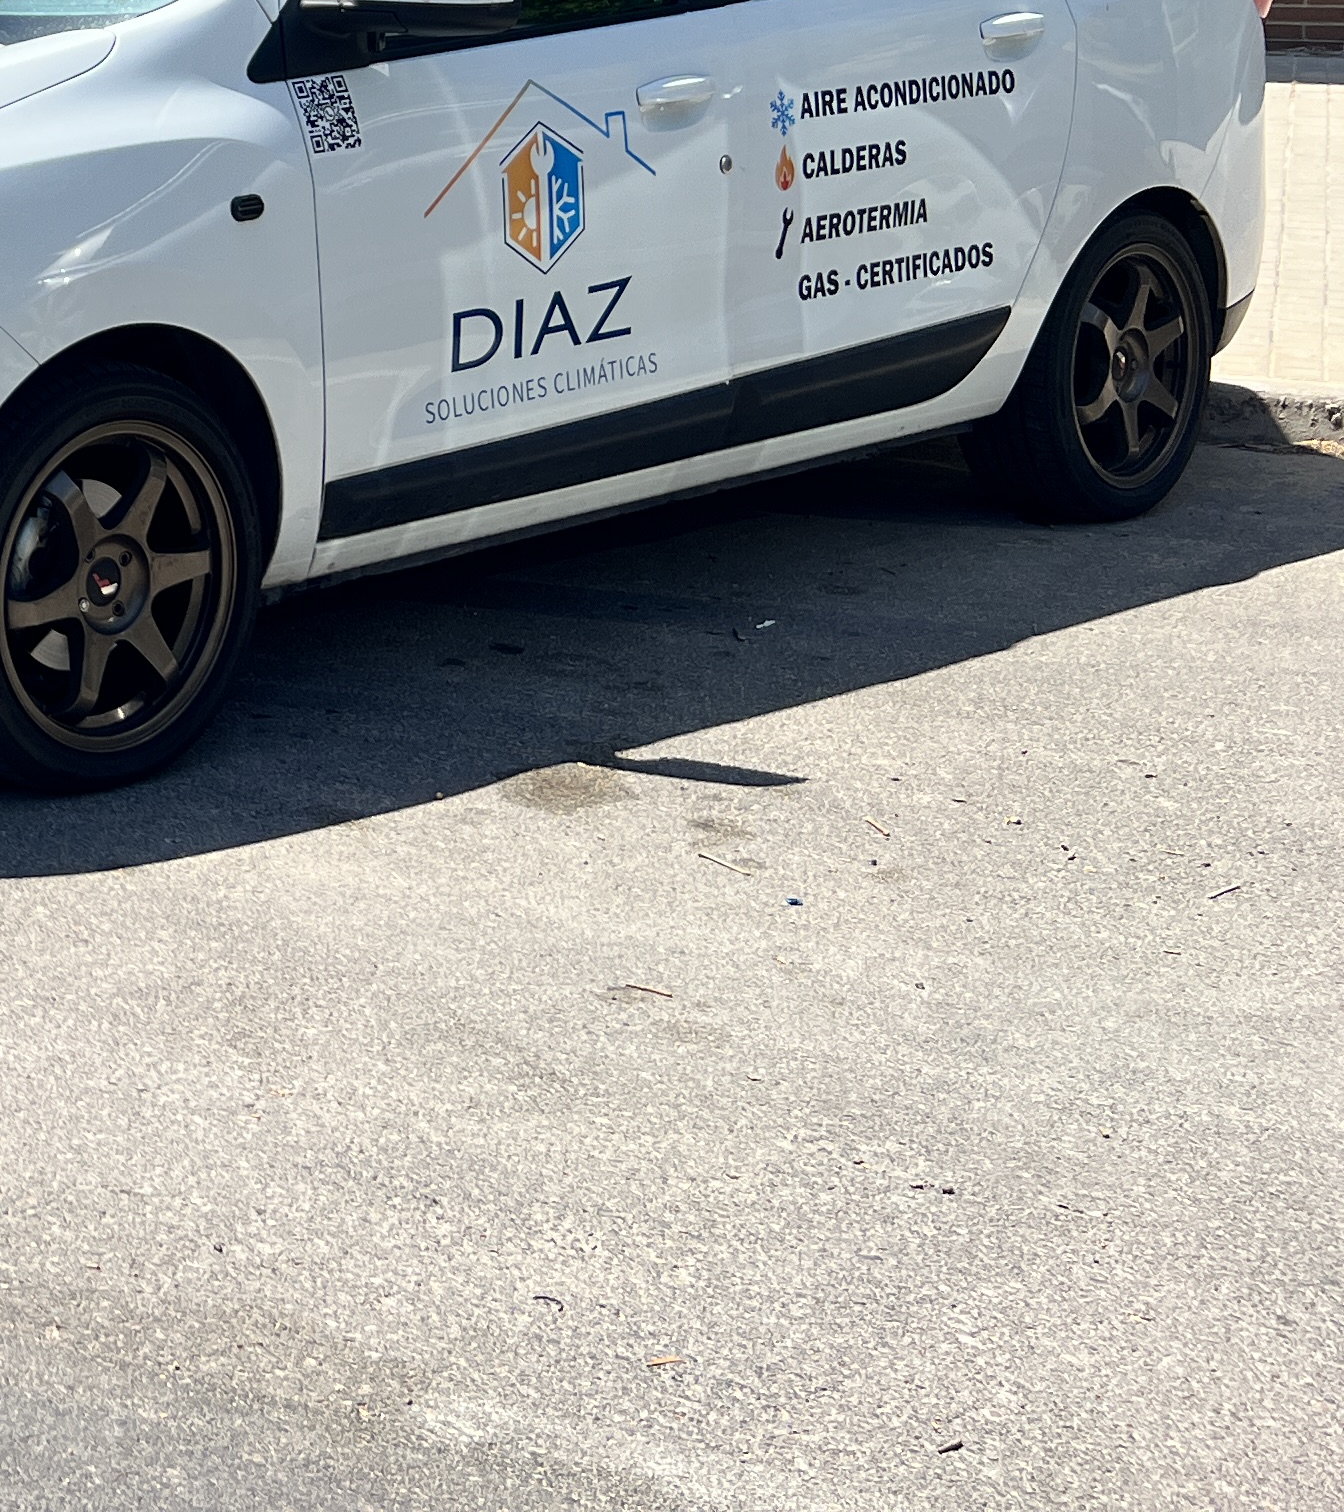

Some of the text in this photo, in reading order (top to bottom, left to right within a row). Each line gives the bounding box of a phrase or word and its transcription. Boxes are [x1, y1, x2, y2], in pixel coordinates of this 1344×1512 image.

[800, 69, 1015, 119] AIRE ACONDICIONADO
[802, 140, 907, 179] CALDERAS
[800, 198, 928, 244] AEROTERMIA
[798, 269, 839, 301] GAS
[856, 242, 994, 290] CERTIFICADOS
[451, 275, 632, 373] DIAZ
[425, 352, 658, 424] SOLUCIONES CLIMÁTICAS
